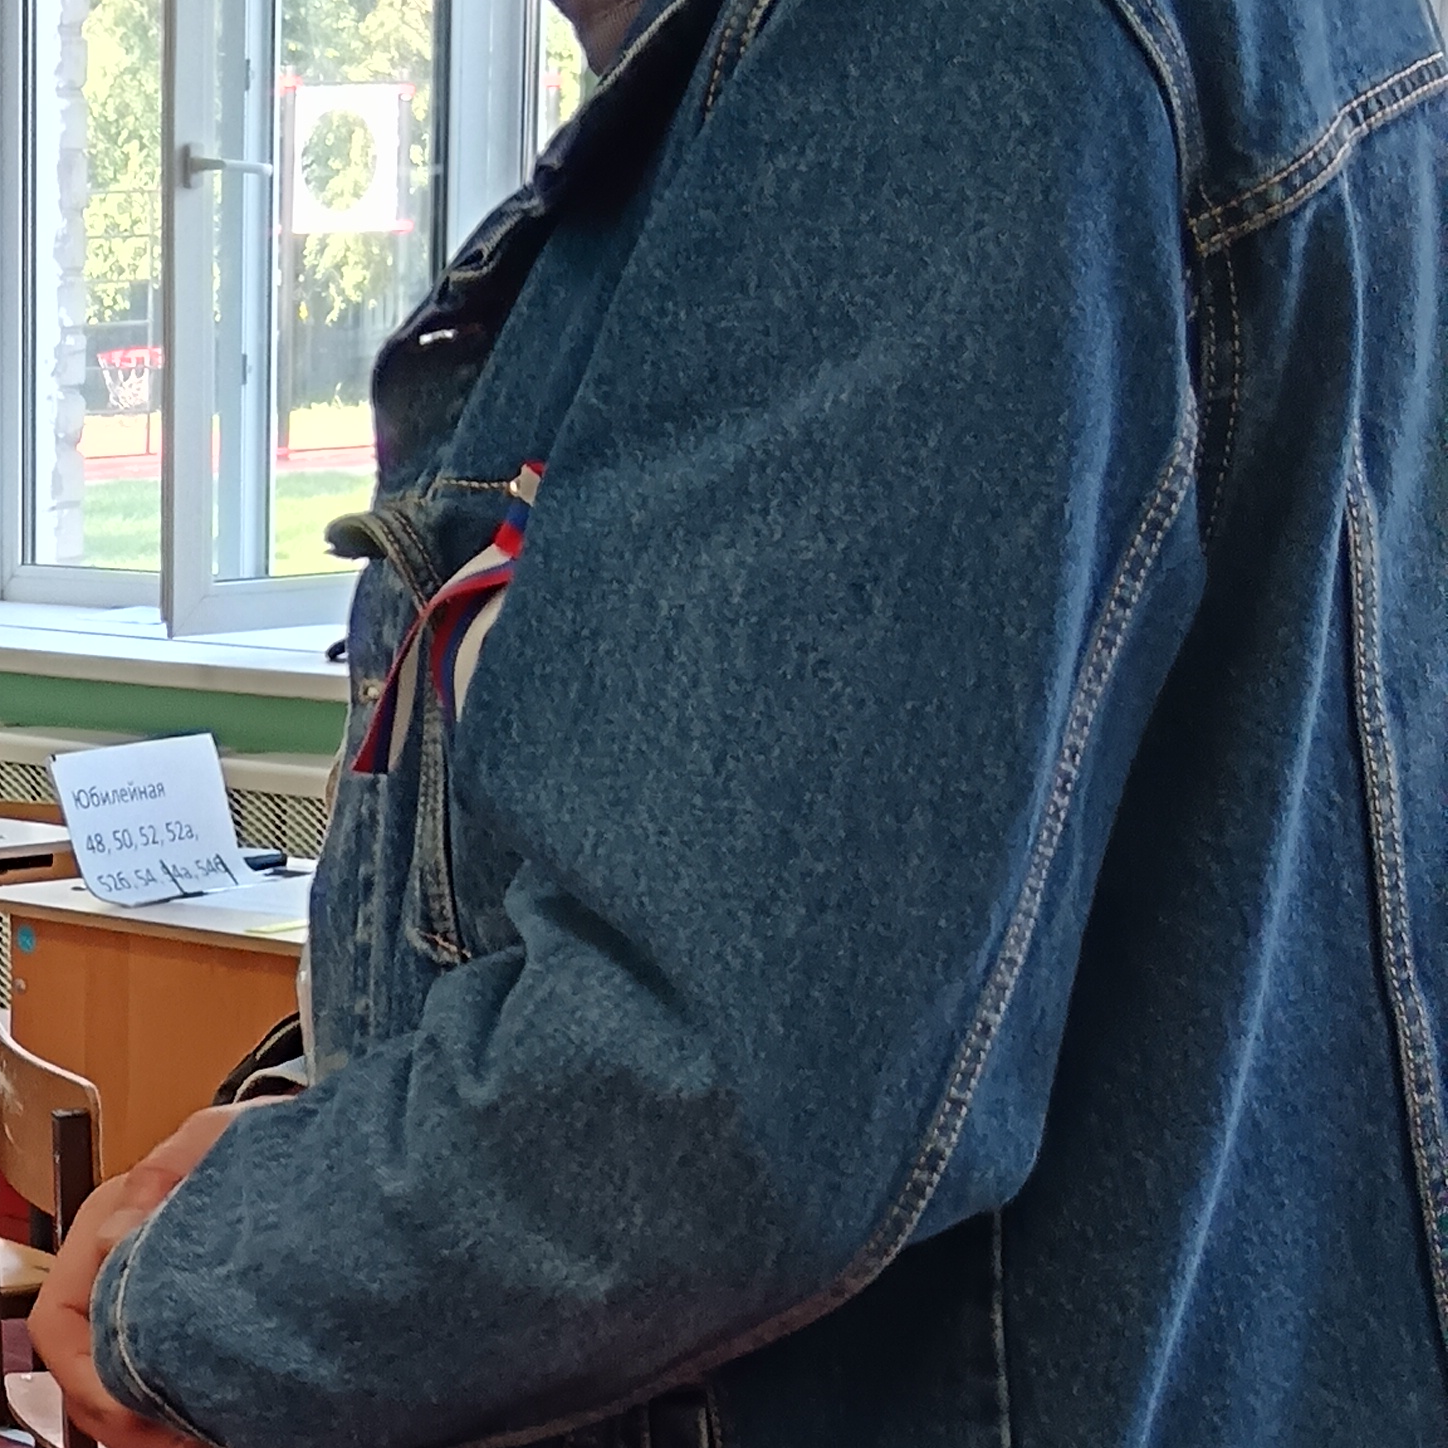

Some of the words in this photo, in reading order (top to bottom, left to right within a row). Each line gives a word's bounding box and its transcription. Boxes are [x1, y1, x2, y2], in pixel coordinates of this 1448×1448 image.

[72, 781, 166, 810] Юбилейная
[86, 832, 111, 854] 48,
[112, 828, 138, 850] 50,
[140, 824, 164, 846] 52,
[165, 820, 199, 842] 52а,
